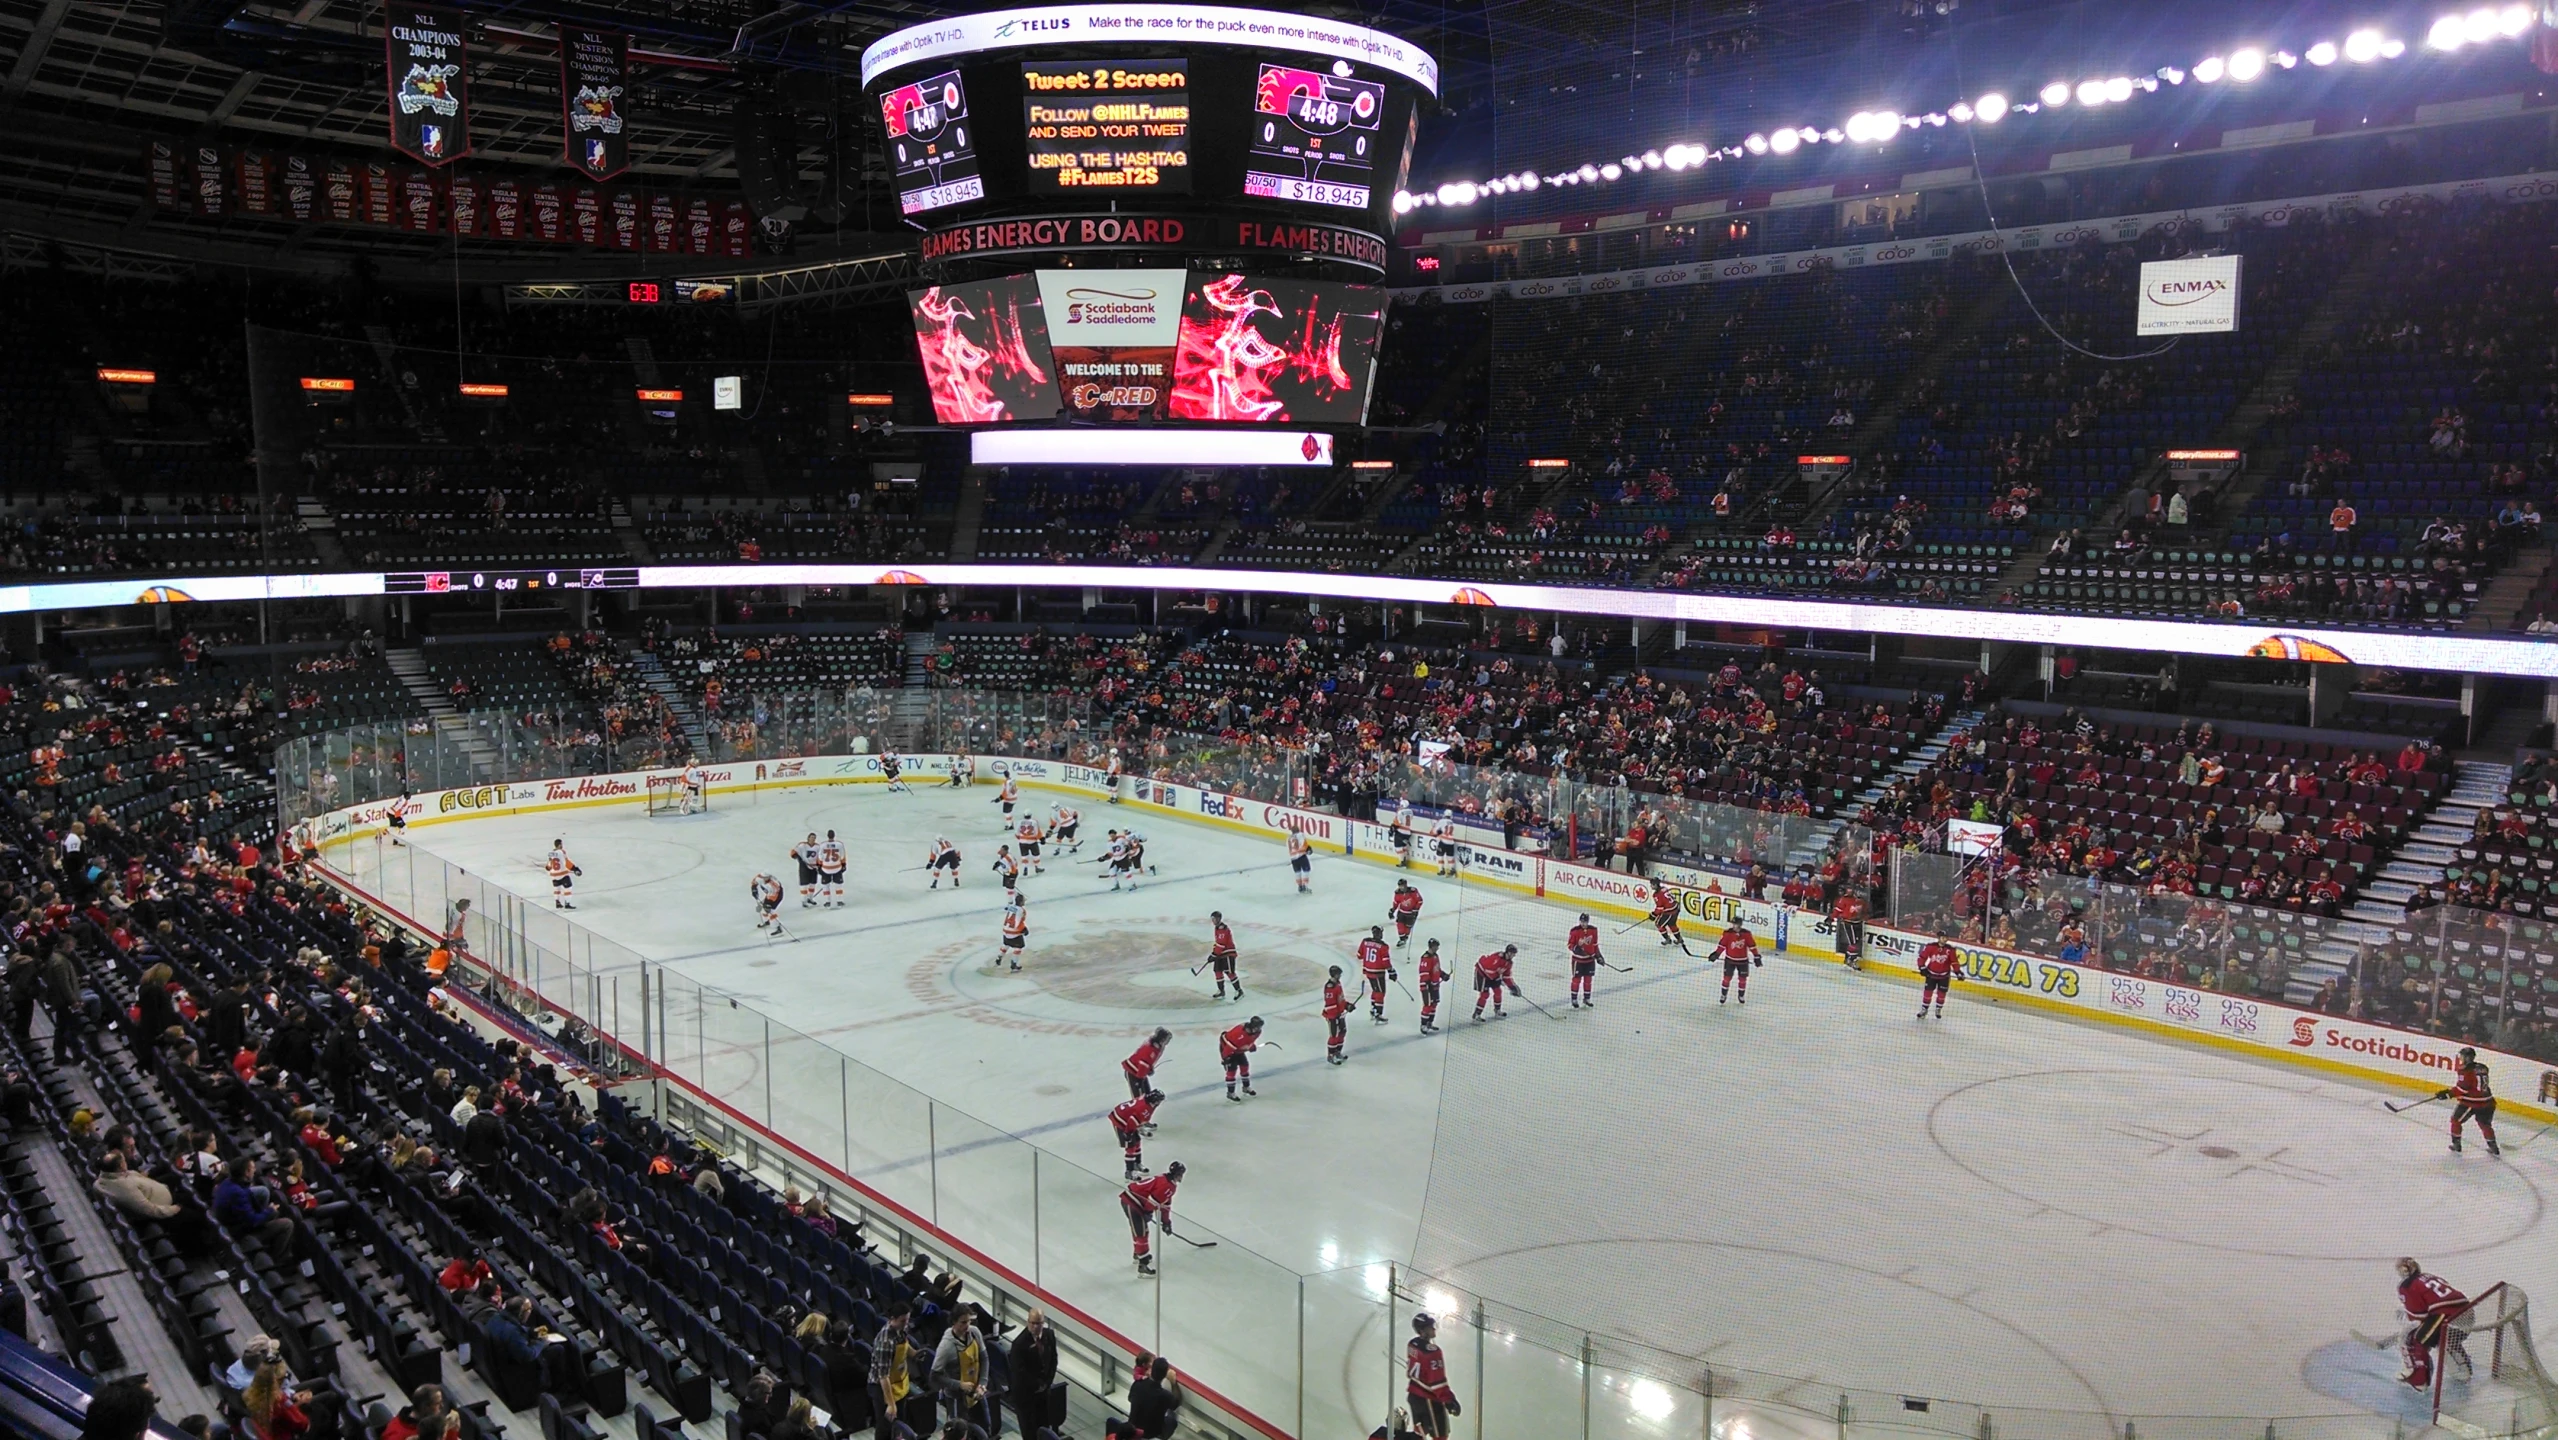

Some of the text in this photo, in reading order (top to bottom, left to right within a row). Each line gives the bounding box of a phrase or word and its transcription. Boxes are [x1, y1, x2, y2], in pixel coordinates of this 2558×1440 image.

[415, 14, 436, 26] NLL
[1021, 18, 1070, 31] TELUS
[392, 26, 460, 47] CHAMPIONS
[584, 33, 601, 43] NLL
[899, 41, 912, 53] with
[914, 36, 933, 50] Optik
[935, 32, 945, 44] TV
[1089, 16, 1121, 28] Make
[1125, 16, 1144, 28] the
[1147, 18, 1173, 28] race
[1176, 17, 1193, 29] for
[1196, 18, 1214, 30] the
[1218, 20, 1246, 33] puck
[1248, 23, 1275, 35] even
[1278, 26, 1304, 38] more
[1307, 28, 1340, 44] intense
[1342, 34, 1360, 48] with
[1361, 39, 1382, 54] Optik
[1383, 45, 1392, 56] TV
[409, 43, 447, 60] 2003-04
[574, 41, 613, 55] WESTERN
[576, 51, 614, 64] DIVISION
[570, 61, 619, 76] CHAMPIONS
[1025, 69, 1185, 90] Tweet 2 Screen
[1300, 99, 1338, 125] 4:48
[957, 127, 965, 147] 0
[1029, 123, 1187, 138] AND SEND YOUR TWEET
[1263, 121, 1275, 142] 0
[927, 144, 937, 155] 1ST
[1310, 137, 1321, 148] 1ST
[1356, 136, 1366, 156] 0
[898, 143, 906, 163] 0
[1029, 151, 1187, 168] USING THE HASHTAG
[1282, 145, 1345, 161] SHOTS PERIOD SHOTS
[1245, 174, 1276, 188] 50/50
[922, 219, 1184, 261] FLAMES ENERGY BOARD
[1240, 222, 1329, 253] FLAMES
[1334, 231, 1381, 264] ENERGY
[629, 282, 658, 303] 6:38
[2162, 280, 2227, 293] ENMAX
[1085, 303, 1155, 314] Scotiabank
[1085, 314, 1156, 325] Saddledome
[2142, 317, 2230, 329] ELECTRICITY NATURAL GAS
[1065, 364, 1163, 376] WELCOME TO THE
[1101, 390, 1111, 403] of
[1111, 386, 1157, 406] RED
[2169, 450, 2237, 460] calgaryflames.com
[473, 573, 484, 587] 0
[547, 572, 556, 586] 0
[906, 758, 924, 770] TV
[1023, 763, 1034, 773] the
[440, 785, 534, 813] AGAT Labs
[544, 779, 636, 802] Tim Hortons
[1201, 792, 1244, 820] FedEx
[1264, 806, 1330, 839] Canon
[823, 849, 839, 862] 75
[1475, 852, 1523, 872] RAM
[1554, 870, 1630, 897] AIR CANADA
[1742, 911, 1769, 927] Labs
[1366, 948, 1378, 962] 16
[1955, 947, 2079, 998] PIZZA 73
[2112, 977, 2145, 996] 95.9
[2166, 988, 2200, 1007] 95.9
[2221, 999, 2258, 1019] 95.9
[291, 1191, 306, 1204] 23
